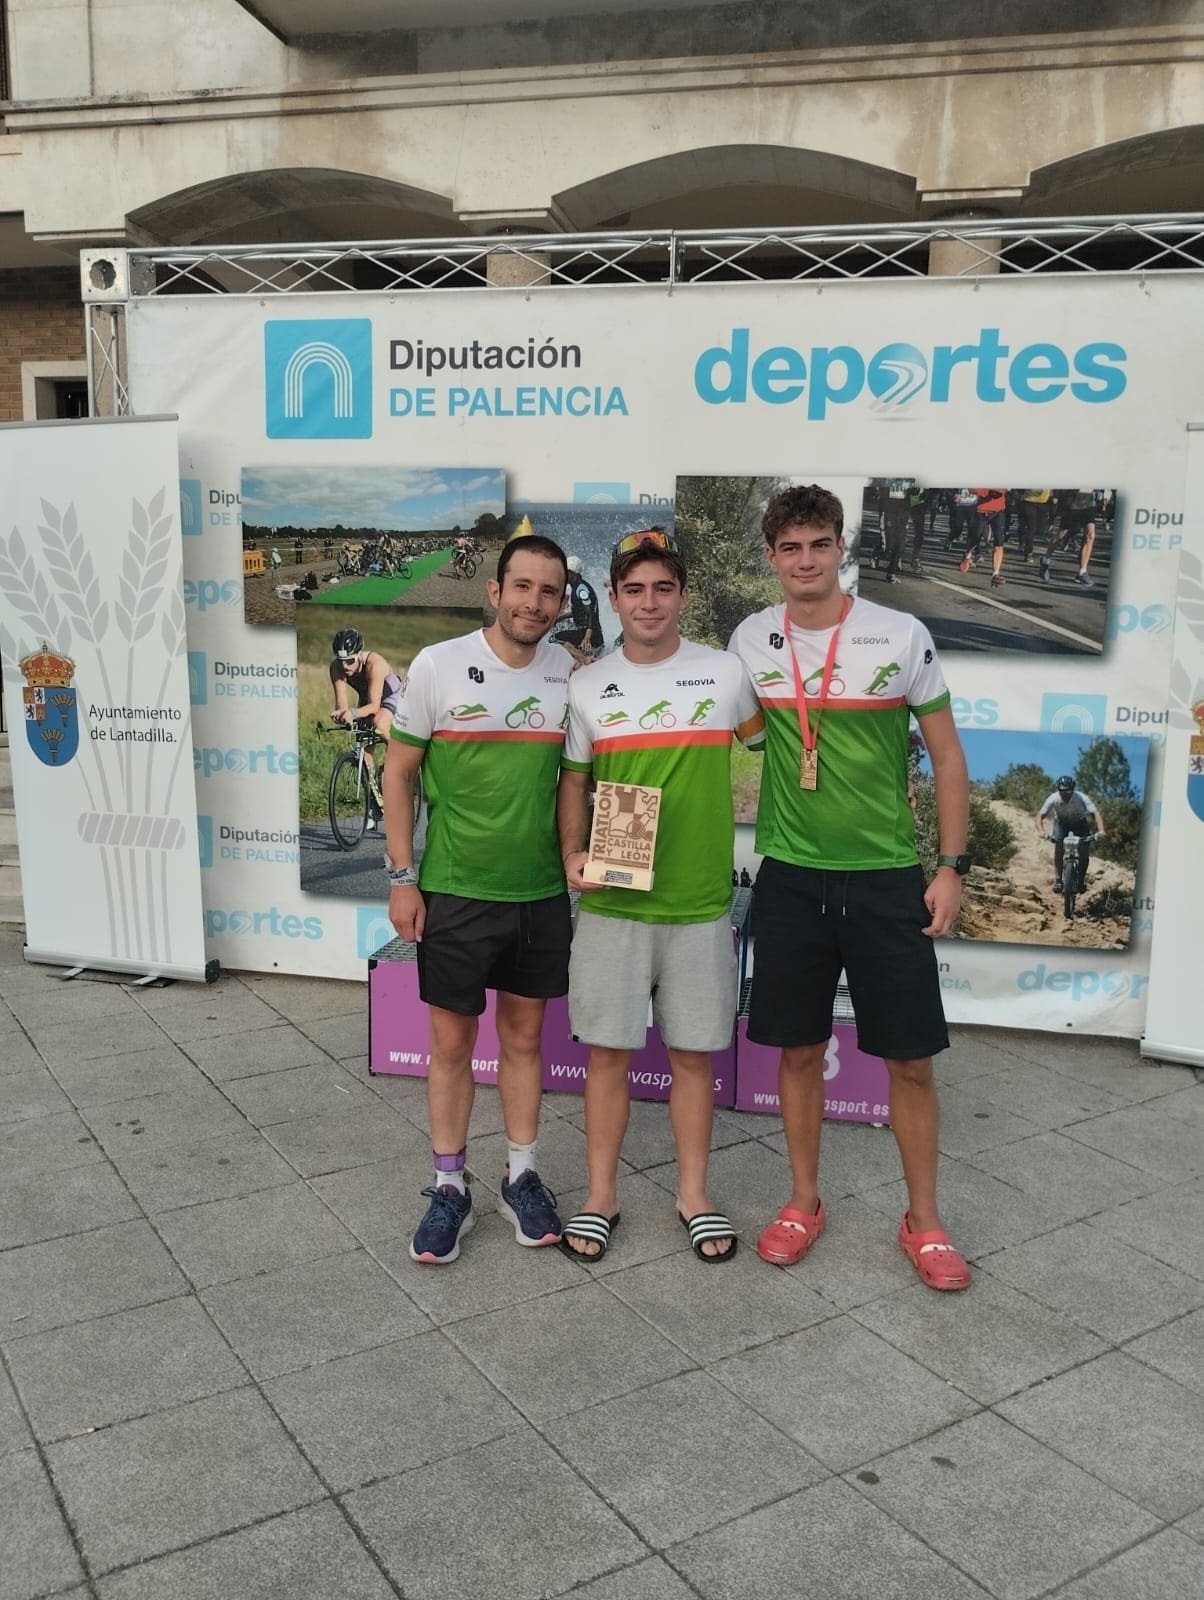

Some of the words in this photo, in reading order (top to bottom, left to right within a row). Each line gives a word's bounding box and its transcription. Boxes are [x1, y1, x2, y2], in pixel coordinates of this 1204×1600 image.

[389, 337, 581, 376] Diputación
[694, 328, 1128, 420] deportes
[389, 388, 436, 417] DE
[449, 386, 629, 417] PALENCIA
[210, 512, 232, 526] DE
[1132, 534, 1161, 550] DE
[214, 661, 298, 679] Diputación
[215, 683, 237, 697] DE
[675, 679, 716, 687] SEGOVIA
[89, 704, 182, 721] Ayuntamiento
[90, 726, 107, 740] de
[110, 727, 177, 743] Lantadilla.
[591, 783, 614, 862] TRIATLON
[220, 826, 300, 843] Diputación
[220, 846, 241, 860] DE
[607, 838, 652, 852] CASTILLA
[607, 848, 613, 857] Y
[621, 849, 651, 861] LEÓN
